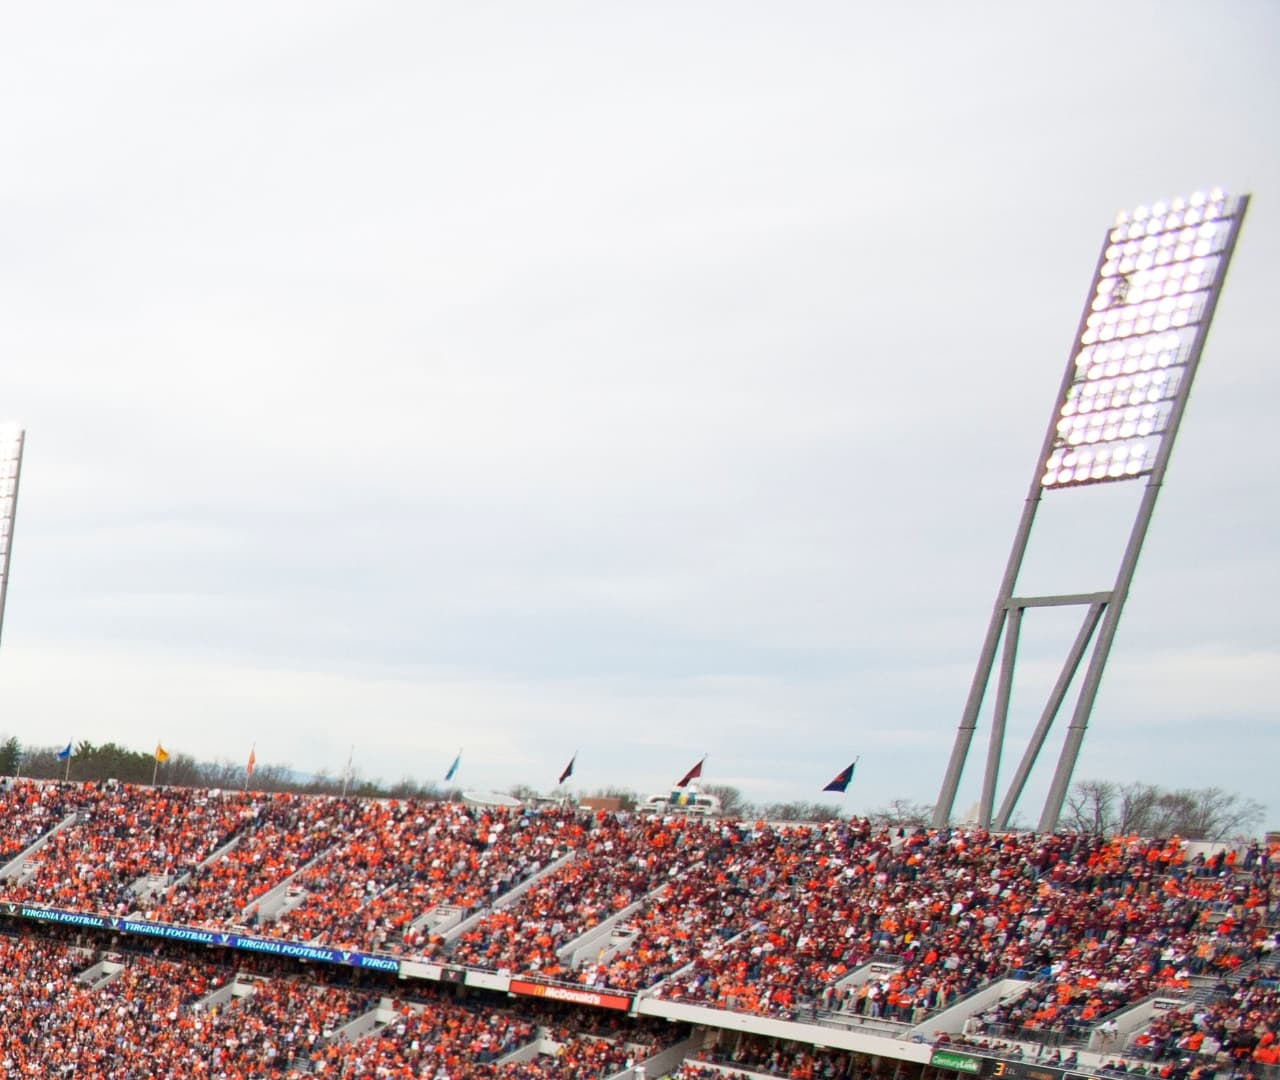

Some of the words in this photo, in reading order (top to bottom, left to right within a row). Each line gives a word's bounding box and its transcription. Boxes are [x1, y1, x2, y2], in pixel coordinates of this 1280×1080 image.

[22, 909, 59, 921] VIRGINIA
[60, 914, 104, 926] FOOTBALL
[124, 922, 164, 935] VIRGINIA
[165, 928, 213, 942] FOOTBALL
[237, 938, 280, 952] VIRGINIA
[282, 945, 333, 960] FOOTBALL
[362, 957, 398, 970] VIRGIN
[545, 987, 601, 1005] McDonald's
[931, 1055, 978, 1072] CenturyLink
[994, 1063, 1006, 1076] 3
